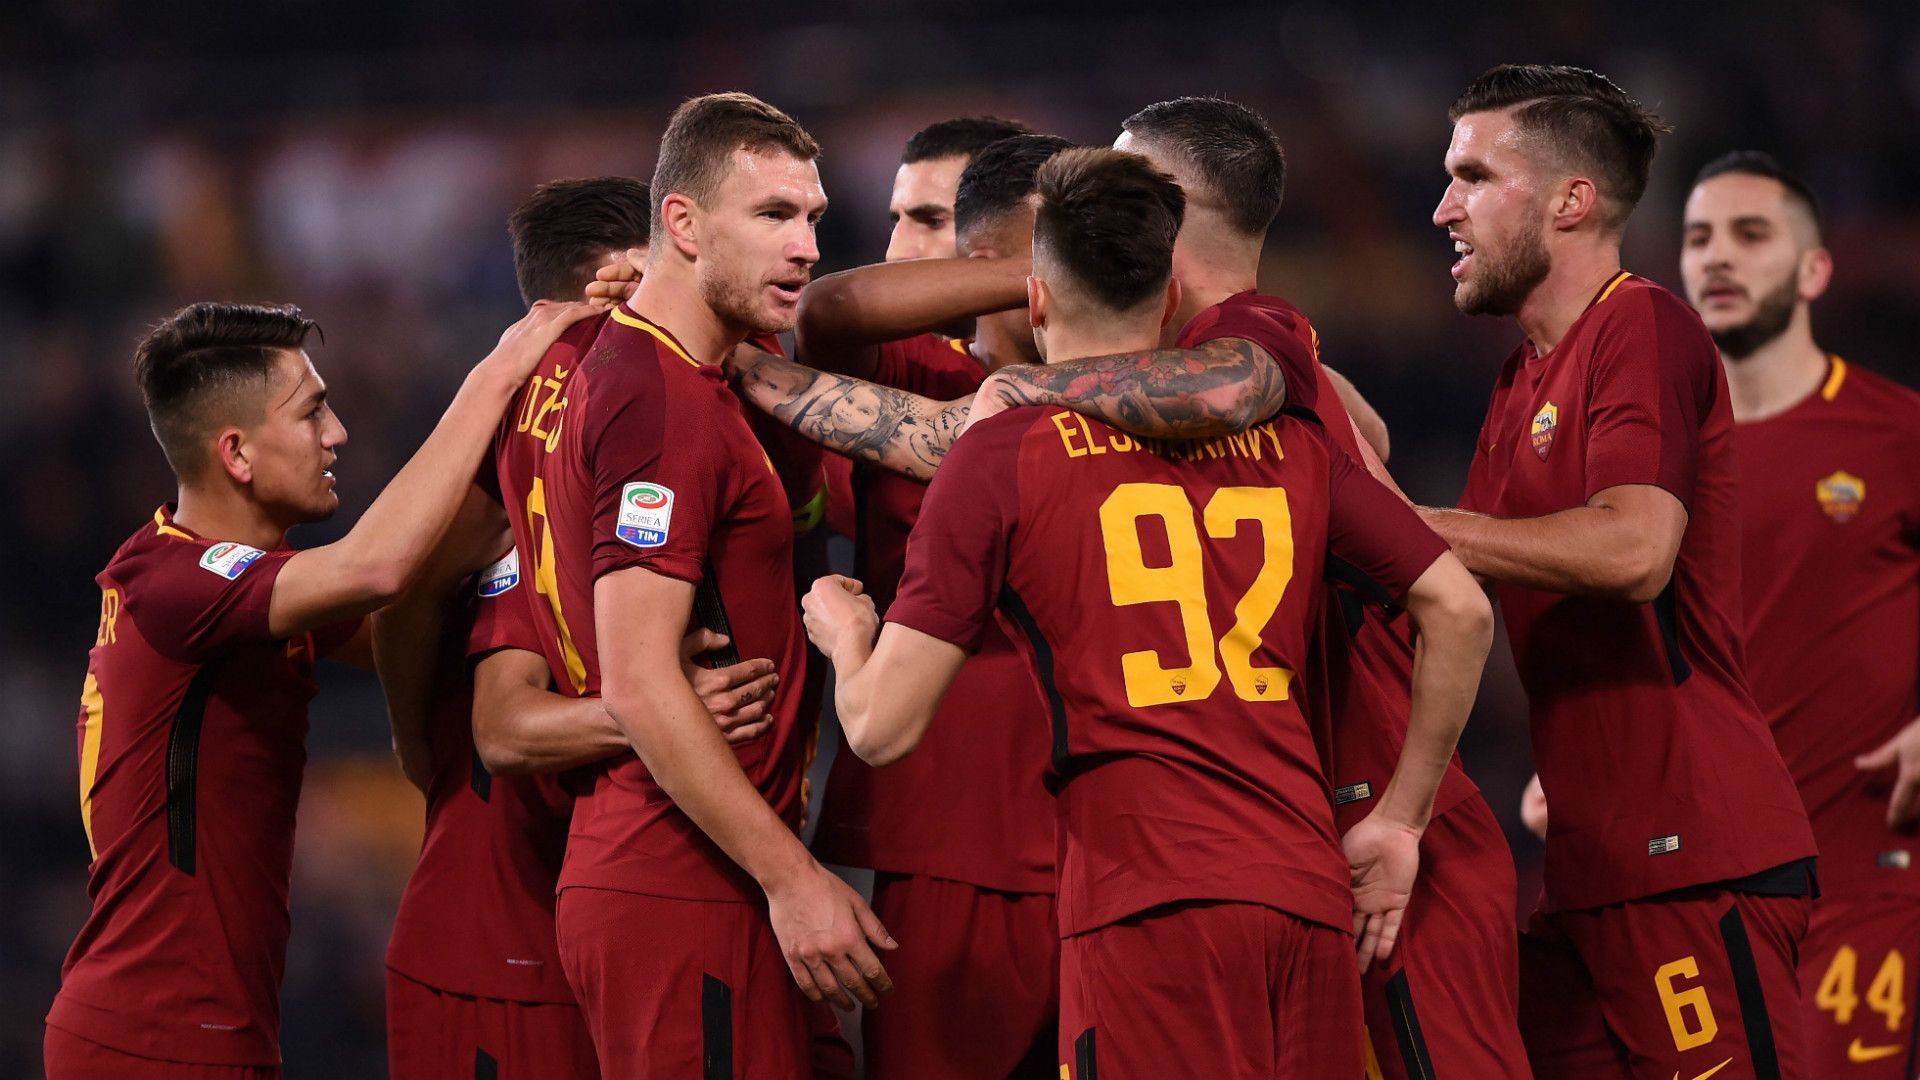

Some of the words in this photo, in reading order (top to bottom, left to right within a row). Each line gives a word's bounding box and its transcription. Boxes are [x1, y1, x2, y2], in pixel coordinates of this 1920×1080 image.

[1051, 410, 1107, 459] EL
[1532, 433, 1553, 446] ROMA
[625, 512, 653, 527] SERIE
[653, 517, 661, 527] A
[637, 530, 659, 544] TIM
[493, 577, 512, 590] TIM
[1099, 482, 1295, 708] 92
[96, 588, 119, 647] ER
[1654, 955, 1718, 1053] 6
[1815, 944, 1906, 1033] 44
